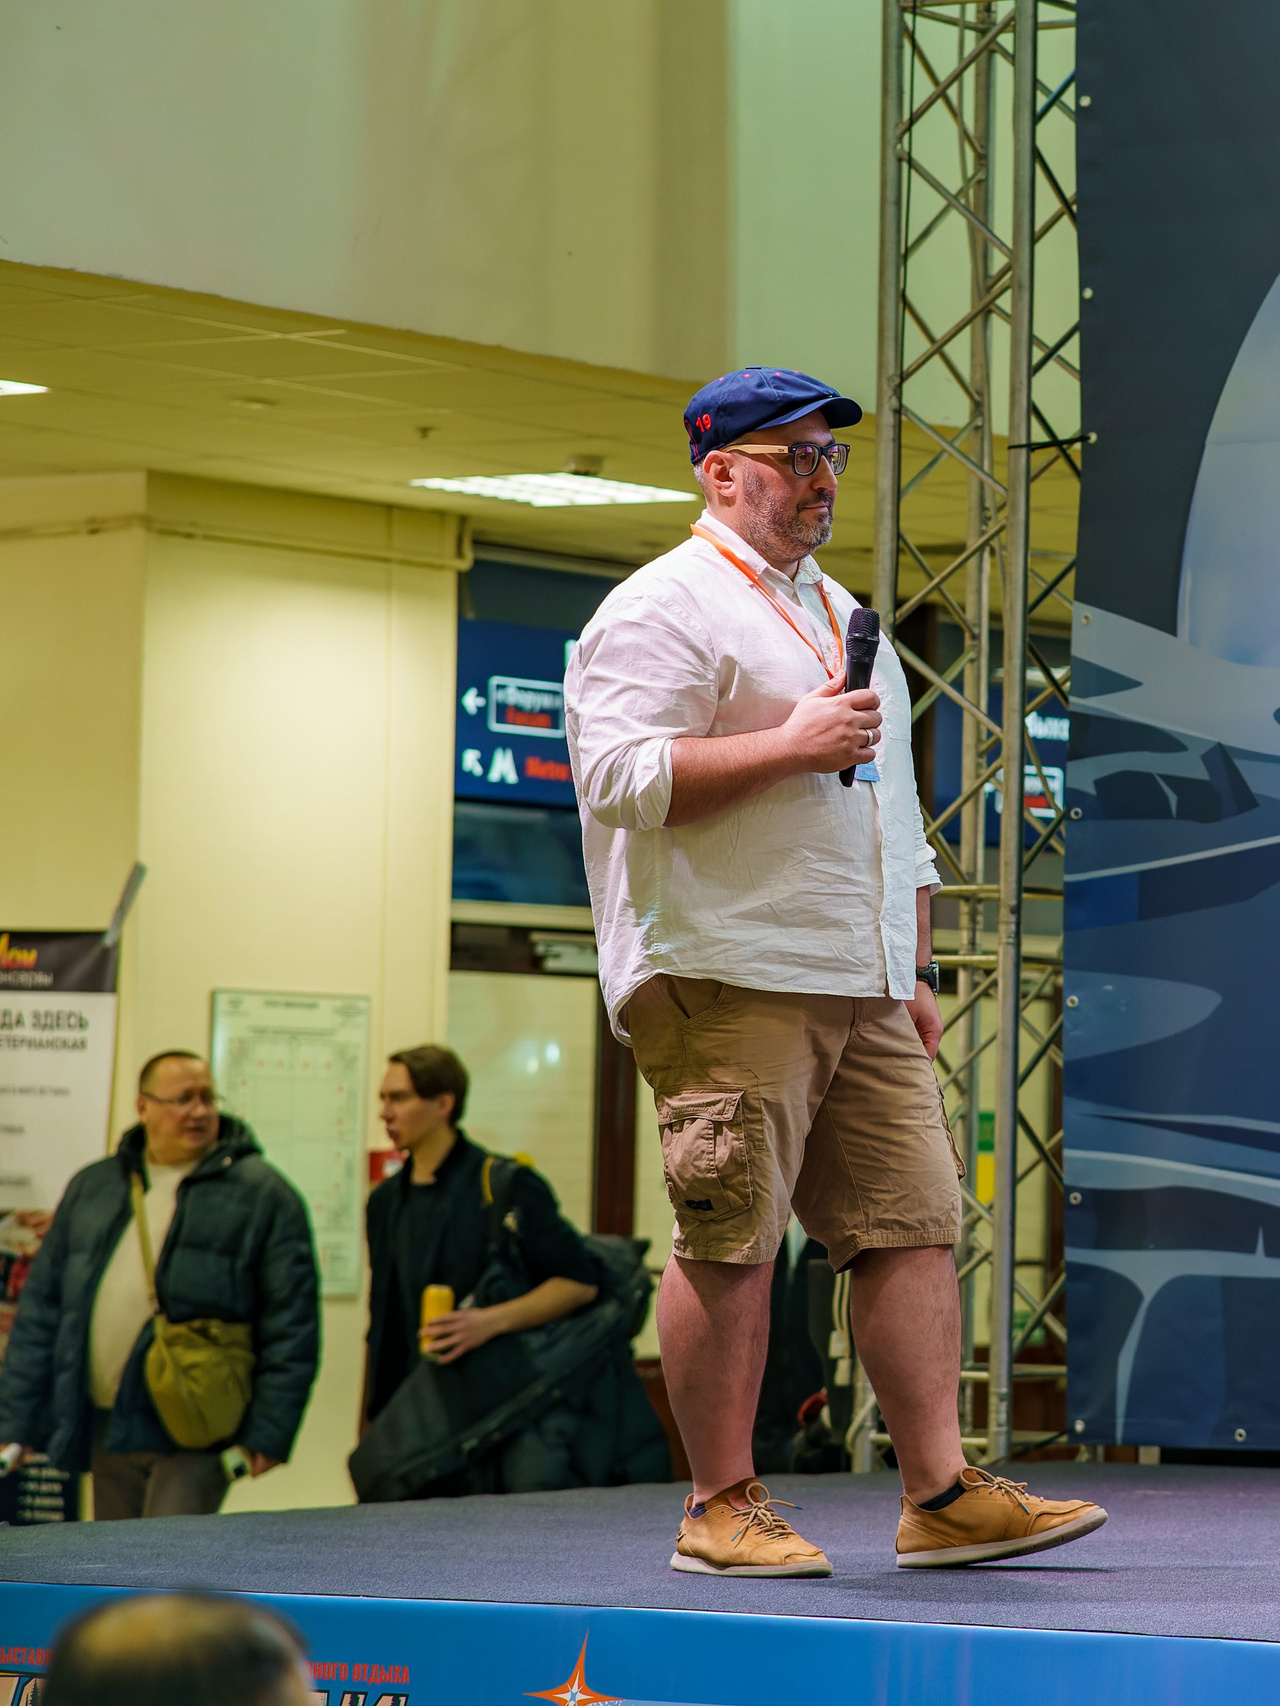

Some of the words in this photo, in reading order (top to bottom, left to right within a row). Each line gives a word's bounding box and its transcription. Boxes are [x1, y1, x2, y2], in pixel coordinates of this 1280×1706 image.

[696, 413, 712, 433] 19
[32, 1010, 90, 1031] ЗДЕСЬ
[352, 1663, 409, 1686] ОТДЫХА
